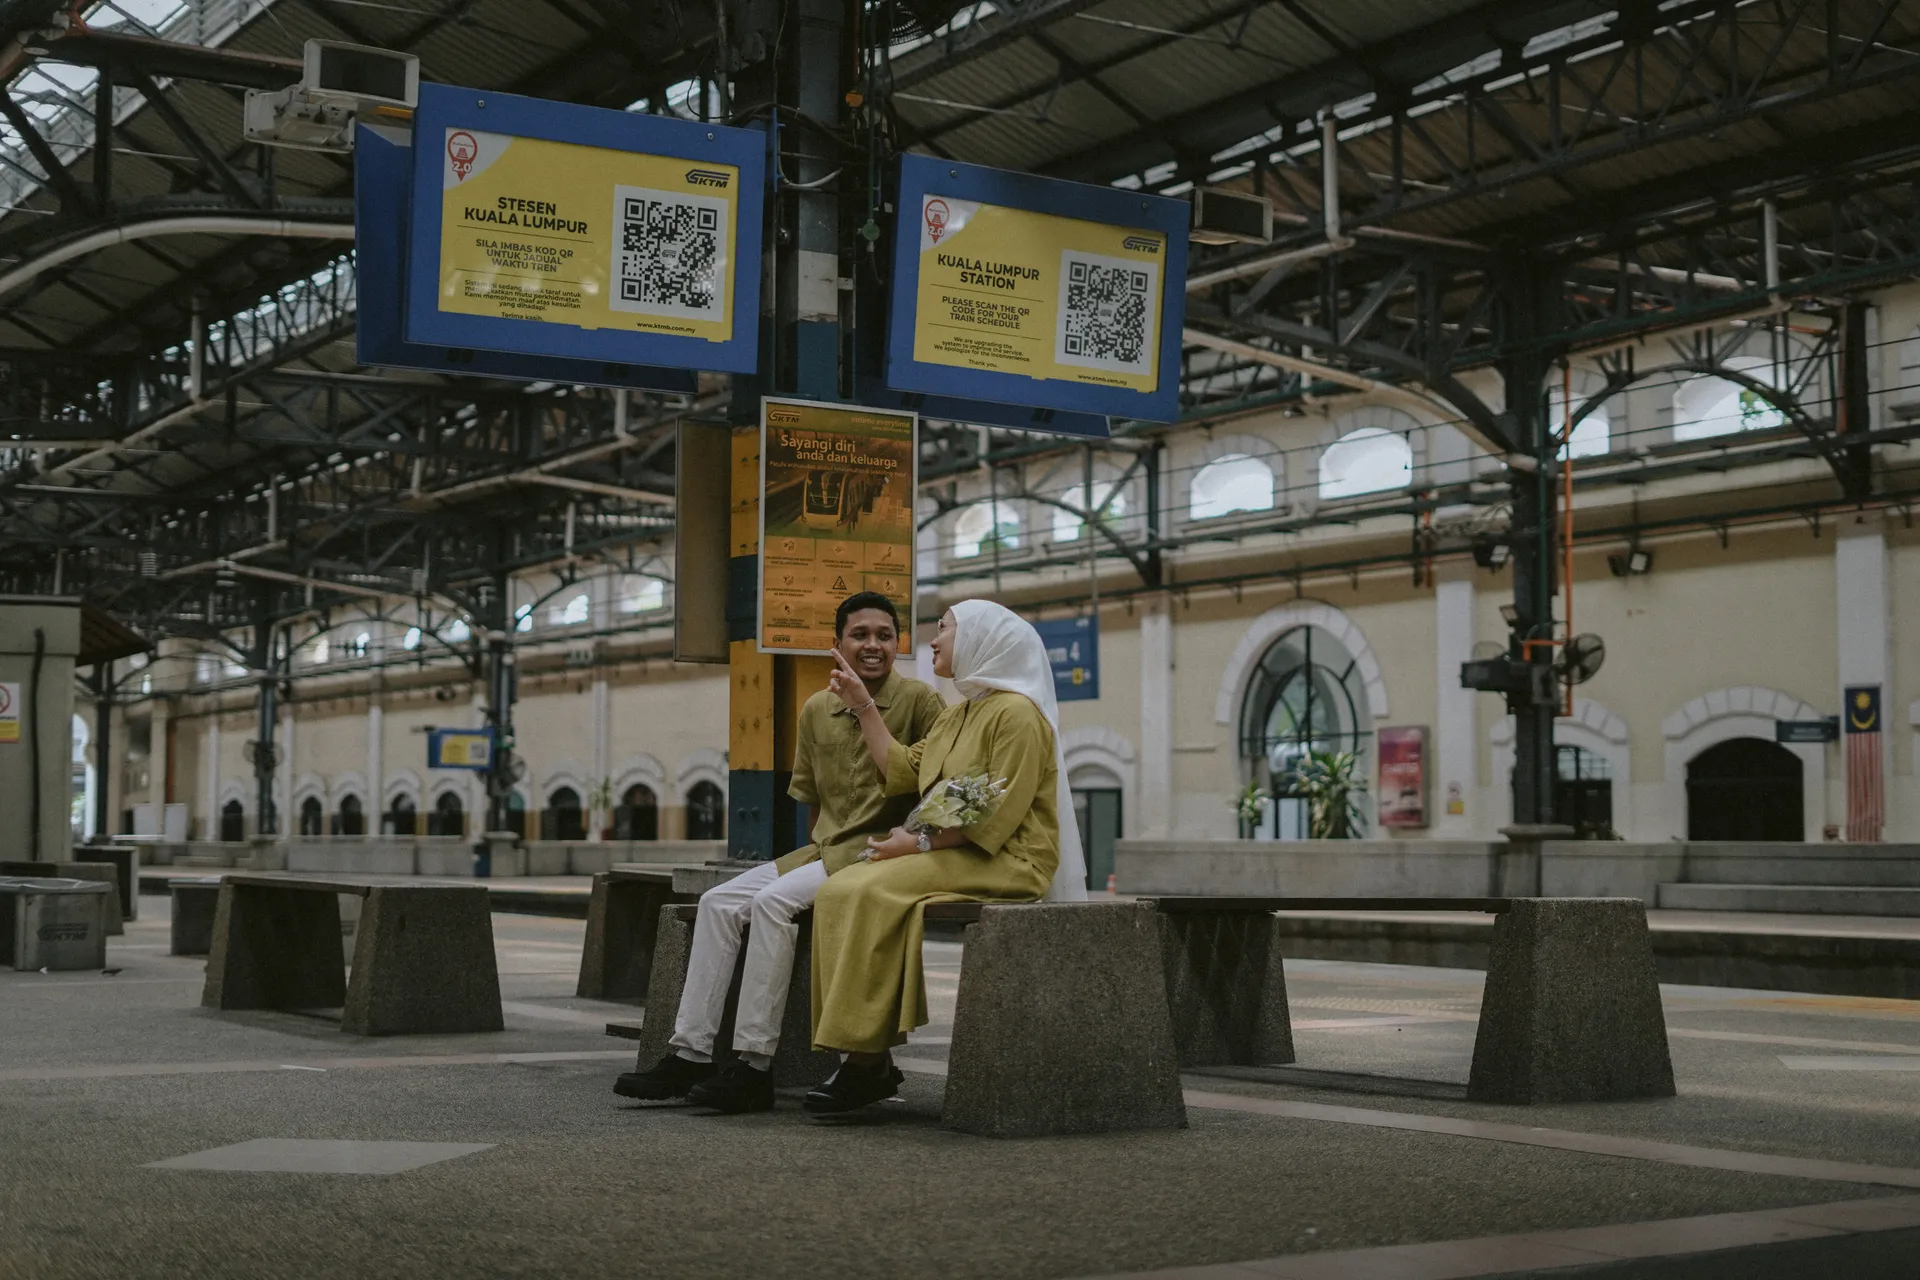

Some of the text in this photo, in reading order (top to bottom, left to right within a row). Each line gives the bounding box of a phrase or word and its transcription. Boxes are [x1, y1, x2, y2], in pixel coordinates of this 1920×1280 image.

[452, 161, 472, 173] 2.0
[698, 177, 728, 188] KTM
[498, 196, 556, 216] STESEN
[464, 207, 588, 234] KUALA LUMPUR
[928, 226, 944, 237] 2.0
[476, 239, 574, 258] SILA IMBAS KOD QR
[1134, 243, 1158, 254] KTM
[486, 248, 562, 264] UNTUK JADUAL
[492, 258, 556, 272] WAKTU TREN
[938, 254, 1040, 280] KUALA LUMPUR
[499, 284, 522, 292] sedang
[960, 272, 1015, 290] STATION
[534, 293, 581, 302] perkhidmatan.
[516, 302, 546, 310] dihadapi.
[942, 296, 1030, 316] PLEASE SCAN THE QR
[502, 312, 524, 320] Terima
[950, 312, 1020, 329] TRAIN SCHEDULE
[952, 306, 975, 315] CODE
[996, 312, 1019, 321] YOUR
[636, 321, 696, 333] www.ktmb.com.my
[974, 340, 1002, 349] upgrading
[944, 346, 970, 354] apologize
[991, 352, 1031, 362] inconvenience.
[1078, 374, 1127, 386] www.ktmb.com.my
[876, 420, 910, 428] everytime
[781, 434, 856, 453] Sayangi diri
[796, 450, 898, 469] anda dan keluarga
[1070, 641, 1080, 662] 4
